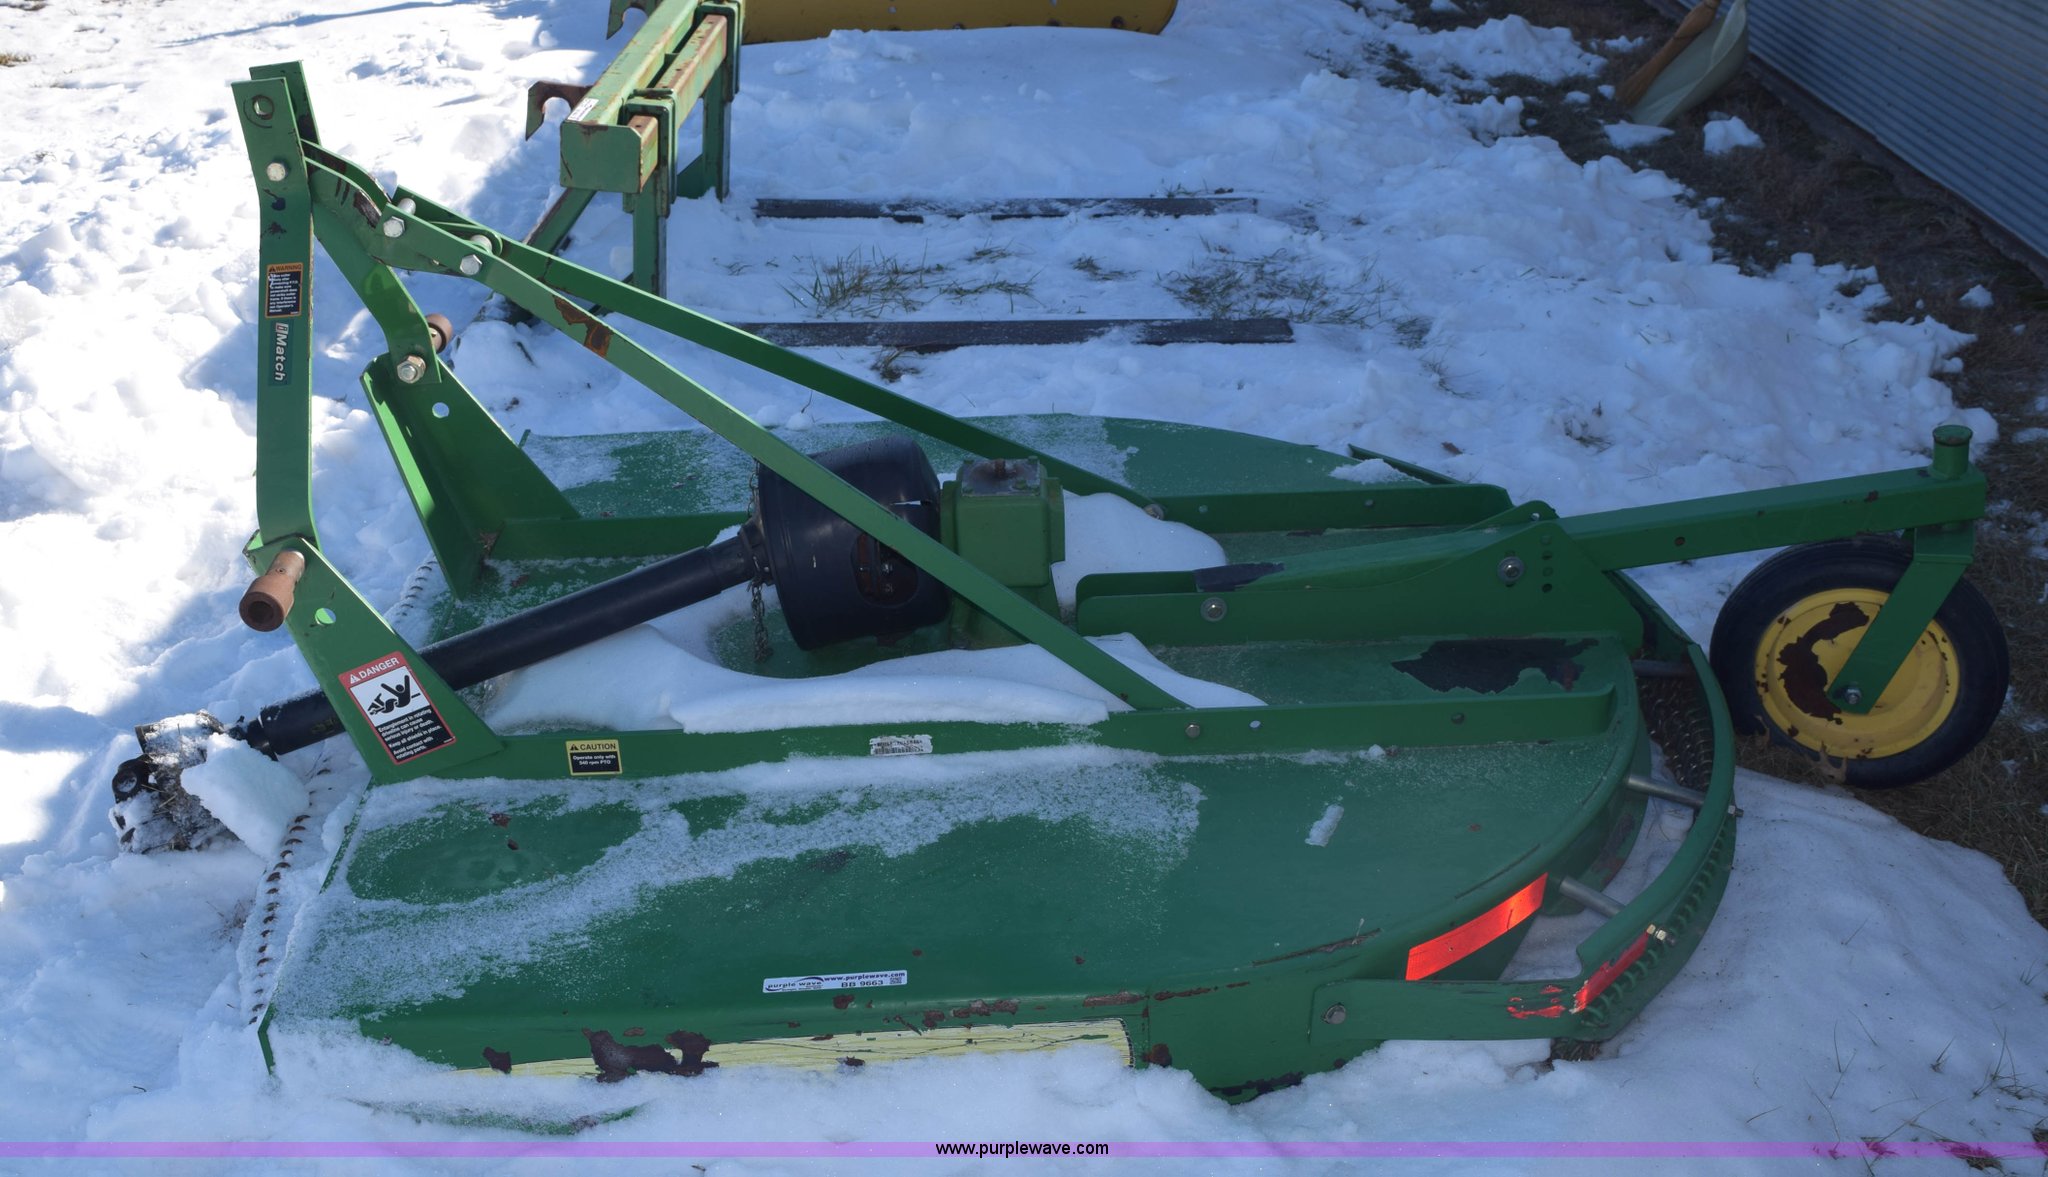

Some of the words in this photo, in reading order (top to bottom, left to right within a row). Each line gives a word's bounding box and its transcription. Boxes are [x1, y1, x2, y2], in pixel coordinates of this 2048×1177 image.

[275, 322, 289, 381] iMatch
[358, 657, 400, 679] DANGER
[378, 717, 409, 732] Entanglement
[414, 708, 432, 718] rotating
[382, 727, 400, 737] driveline
[384, 733, 401, 741] serious
[419, 720, 434, 728] death.
[407, 732, 423, 741] shields
[393, 747, 406, 755] Avoid
[406, 740, 423, 750] contact
[396, 750, 414, 759] rotating
[824, 972, 905, 981] www.purplewave.com
